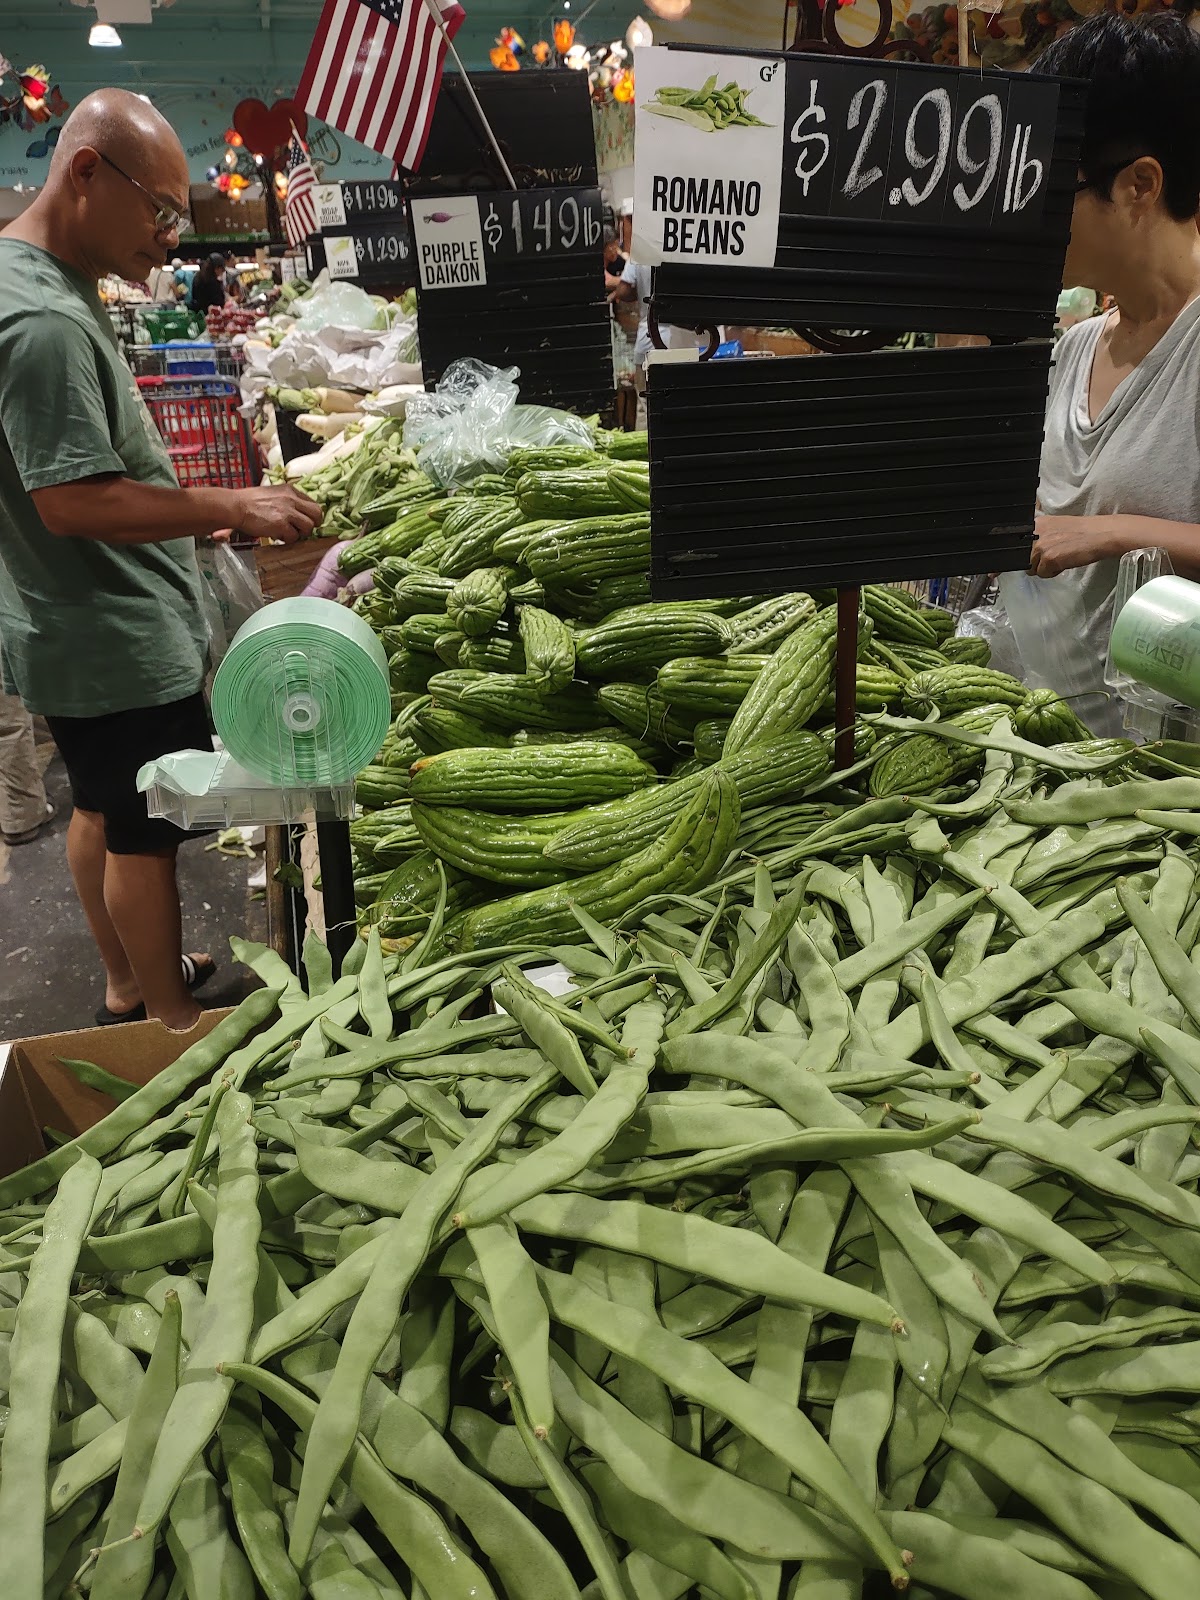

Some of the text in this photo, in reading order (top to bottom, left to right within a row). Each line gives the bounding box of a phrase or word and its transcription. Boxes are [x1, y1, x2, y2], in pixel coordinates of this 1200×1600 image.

[652, 176, 761, 216] ROMANO
[662, 217, 746, 255] BEANS
[422, 241, 479, 264] PURPLE
[425, 262, 480, 285] DAIKON
